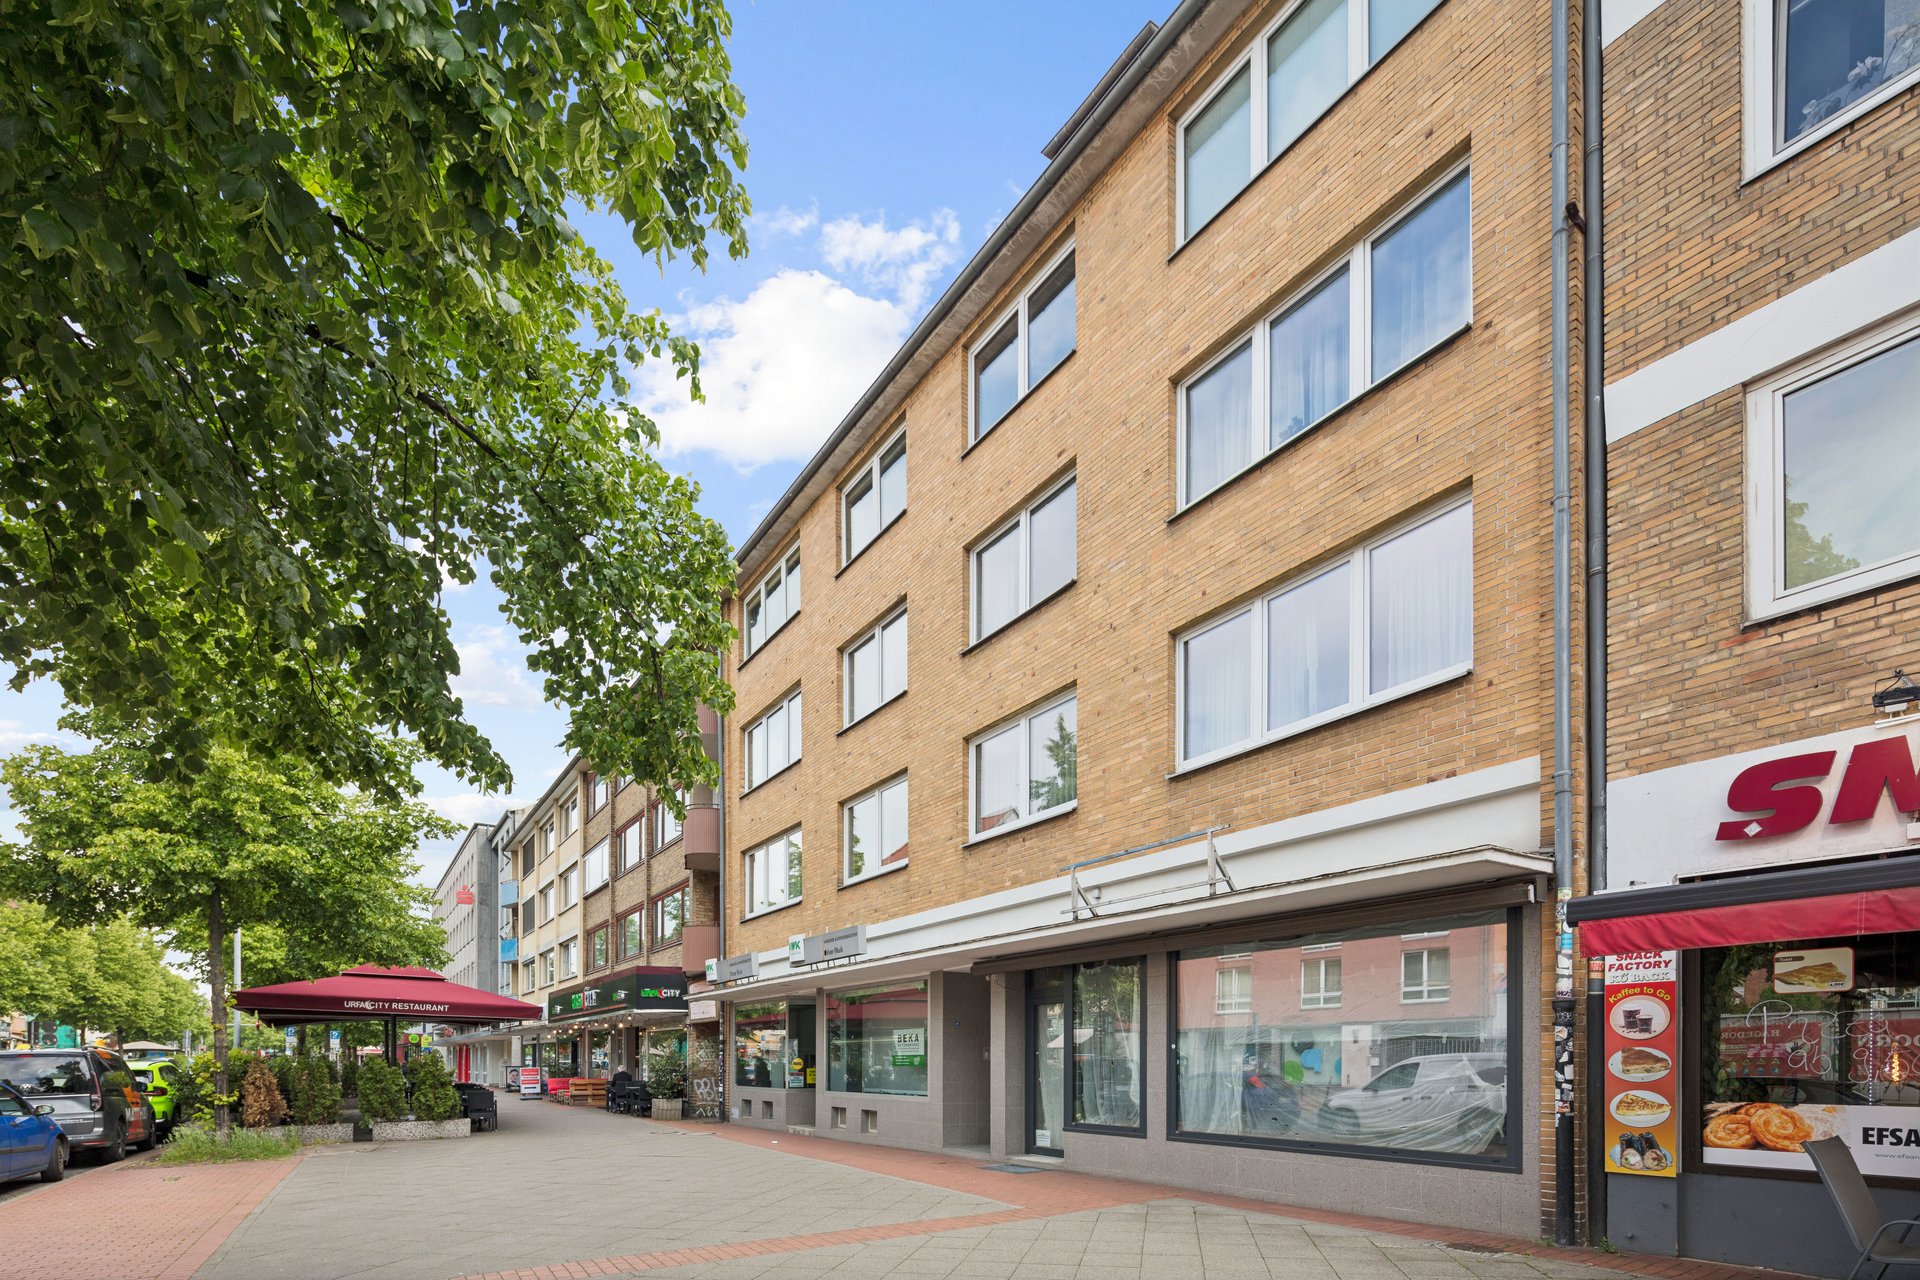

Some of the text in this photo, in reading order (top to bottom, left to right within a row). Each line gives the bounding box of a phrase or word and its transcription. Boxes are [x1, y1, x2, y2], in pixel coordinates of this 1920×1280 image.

[1616, 951, 1662, 961] SNACK
[1608, 960, 1672, 972] FACTORY
[1631, 972, 1670, 983] BACK
[661, 989, 681, 998] CITY
[1609, 986, 1671, 1003] Kaffee to Go
[392, 1002, 449, 1011] RESTAURANT
[897, 1034, 919, 1043] BEKA
[1788, 1046, 1832, 1074] ab
[1862, 1127, 1920, 1147] EFSA
